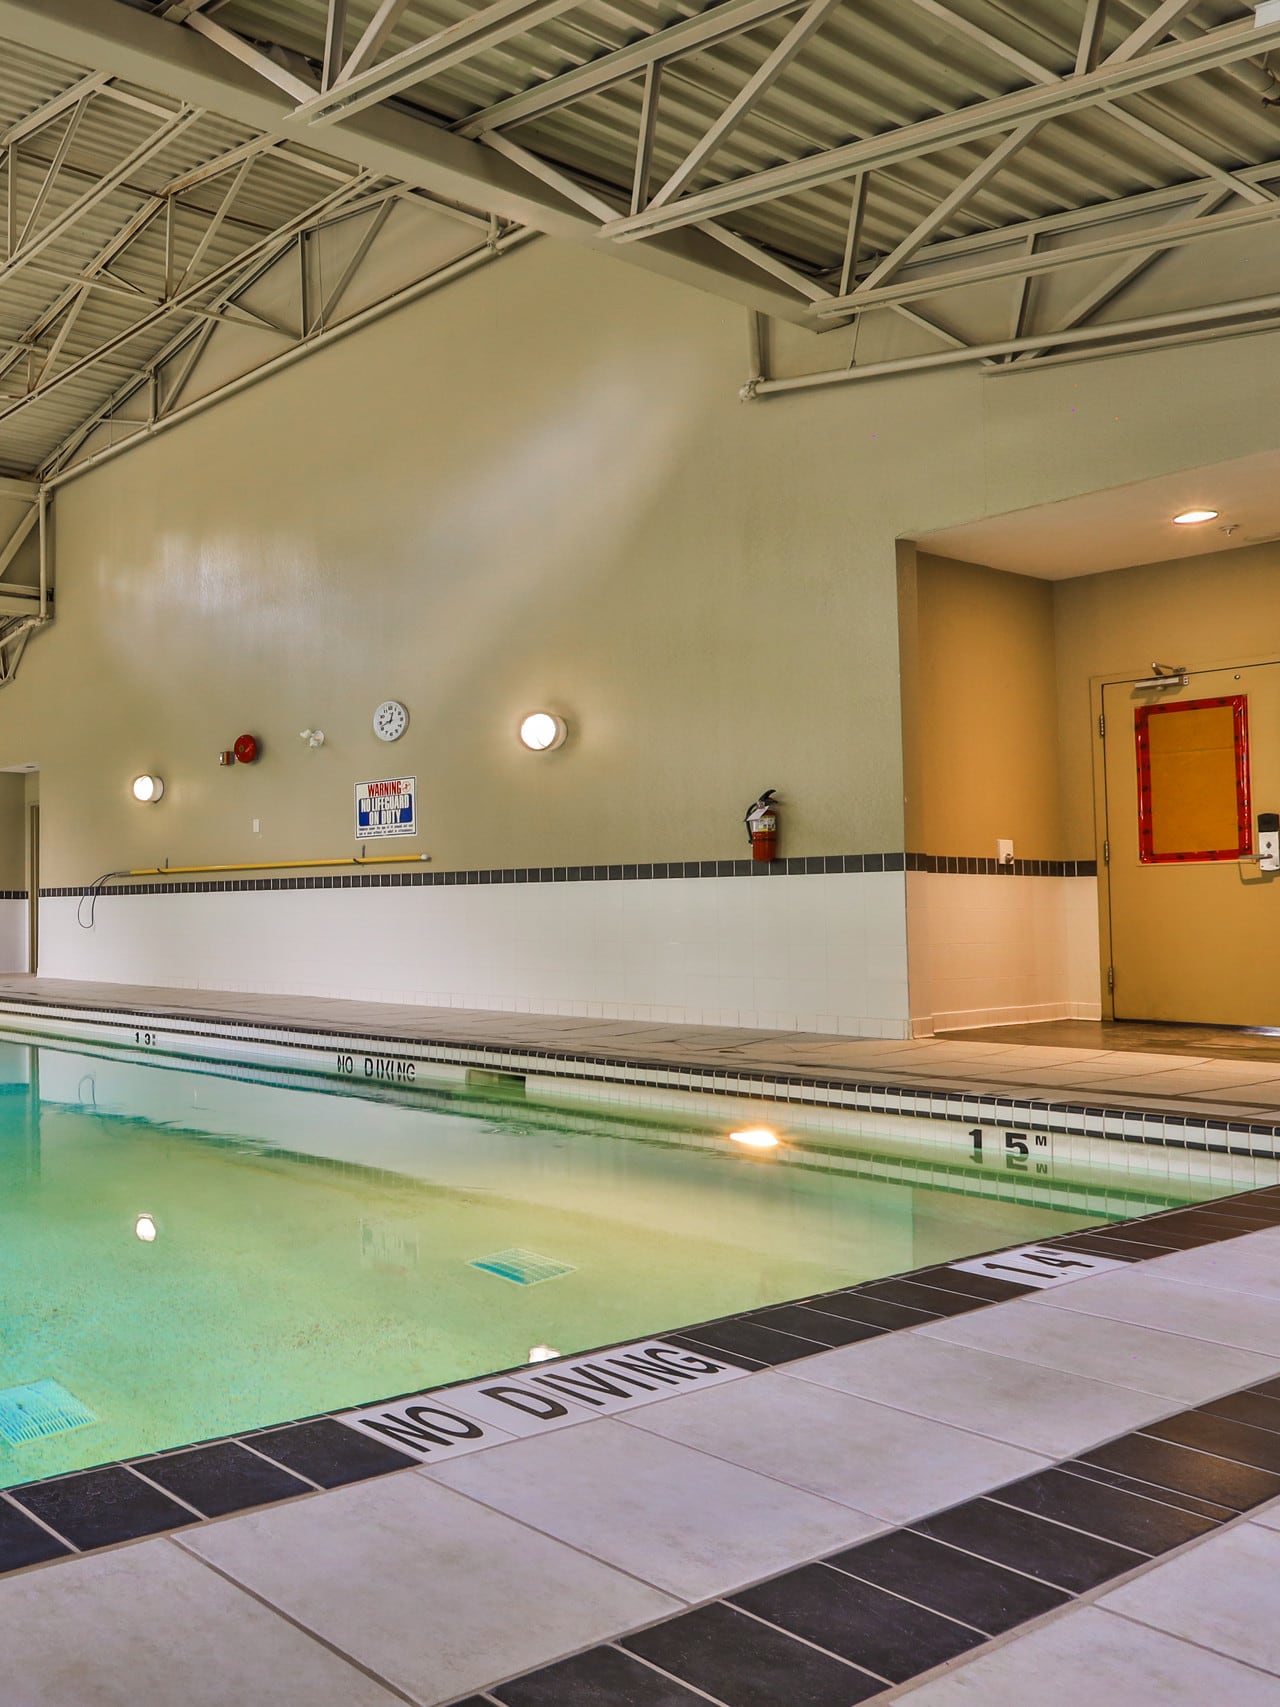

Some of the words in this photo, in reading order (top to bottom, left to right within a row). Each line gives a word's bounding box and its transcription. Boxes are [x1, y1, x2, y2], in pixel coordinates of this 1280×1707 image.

[367, 781, 402, 797] WARNING
[360, 798, 371, 813] NO
[371, 794, 410, 812] LIFEGUARD
[369, 811, 379, 826] ON
[381, 809, 401, 825] DUTY
[337, 1054, 353, 1074] NO
[364, 1057, 416, 1082] DIVING
[358, 1406, 484, 1453] NO
[478, 1347, 727, 1421] DIVING
